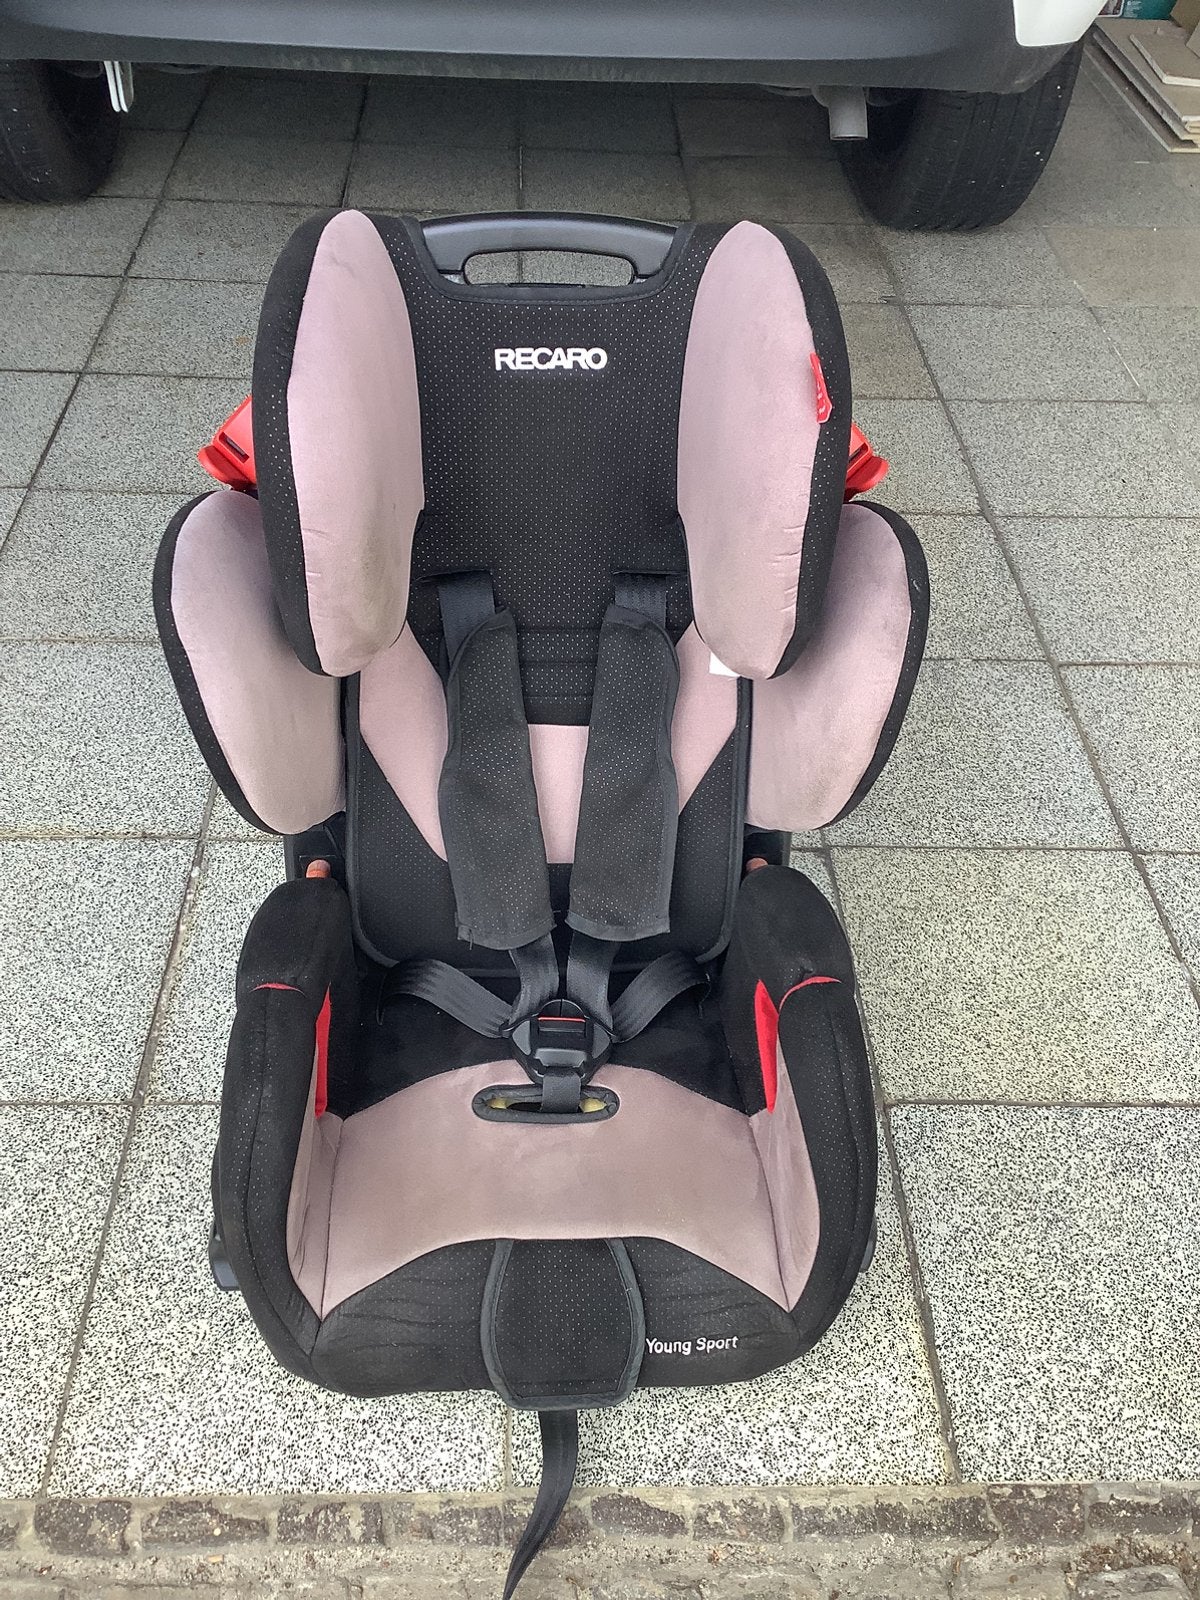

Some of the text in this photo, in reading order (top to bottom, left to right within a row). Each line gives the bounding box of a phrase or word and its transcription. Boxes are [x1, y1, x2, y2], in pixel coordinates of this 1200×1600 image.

[494, 347, 608, 371] RECARO
[645, 1335, 739, 1356] Young Sport
